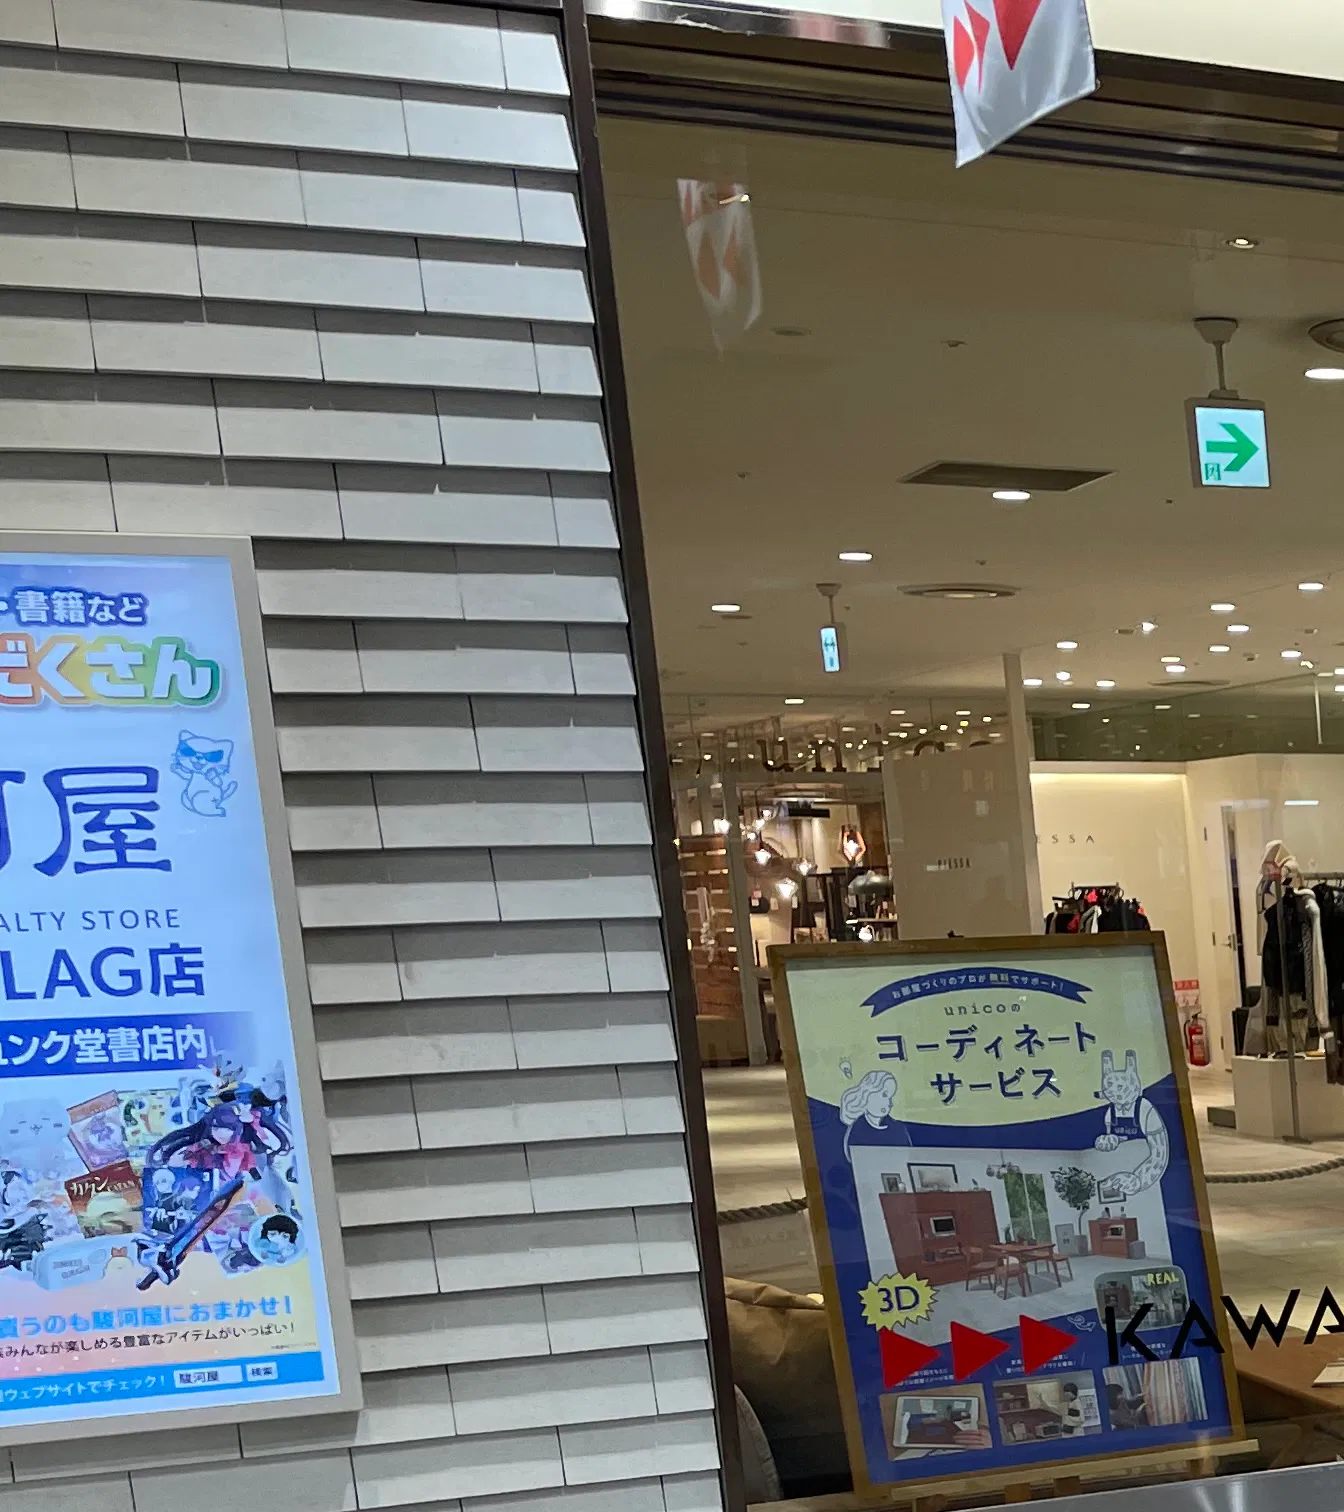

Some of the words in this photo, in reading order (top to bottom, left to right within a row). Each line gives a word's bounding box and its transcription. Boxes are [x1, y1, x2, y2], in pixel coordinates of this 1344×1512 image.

[0, 766, 173, 877] 屋
[82, 908, 181, 932] STORE
[944, 1002, 1021, 1016] unicoの
[876, 1022, 1096, 1062] コーディネート
[930, 1067, 1061, 1105] サービス
[1147, 1272, 1179, 1285] REAL
[877, 1285, 920, 1312] 3D
[0, 1322, 295, 1358] みんなが楽しめる豊富なアイテムがいっぱい!
[0, 1374, 166, 1402] ウェブサイトでチェック!
